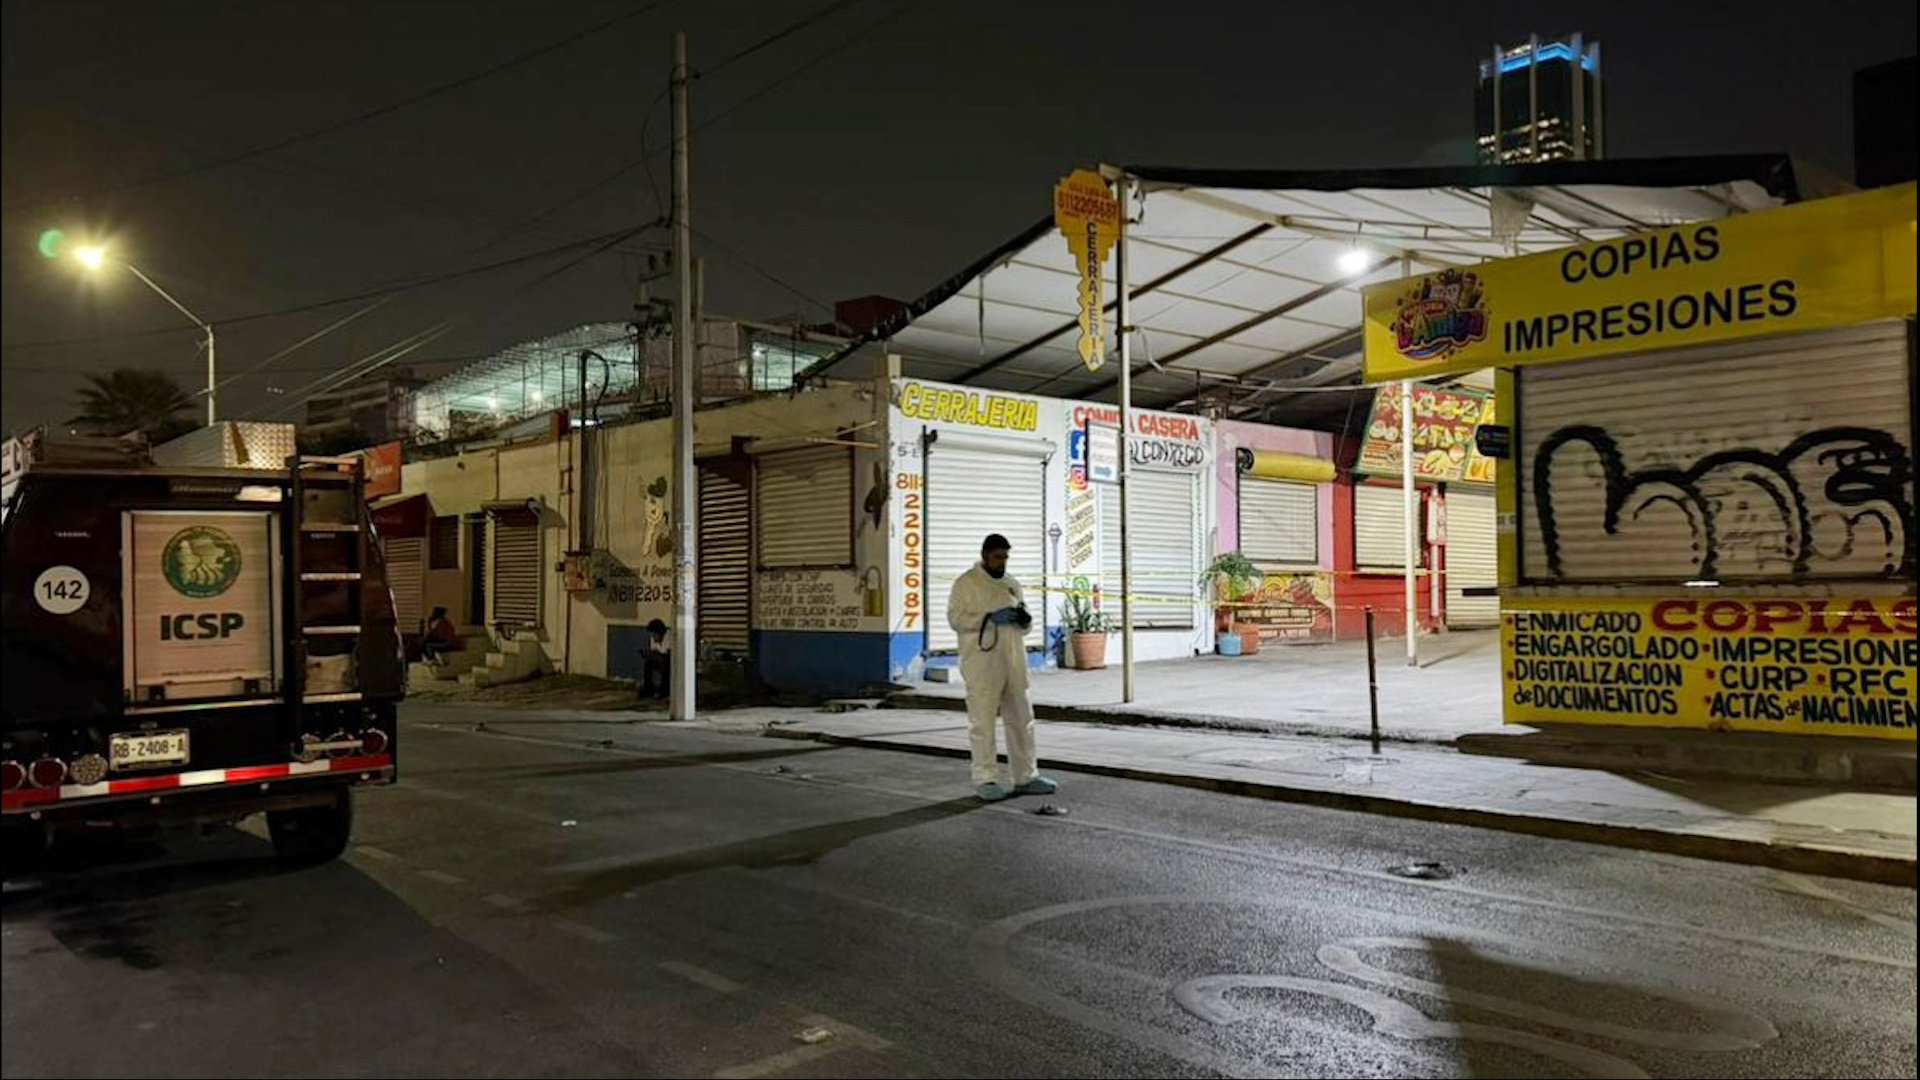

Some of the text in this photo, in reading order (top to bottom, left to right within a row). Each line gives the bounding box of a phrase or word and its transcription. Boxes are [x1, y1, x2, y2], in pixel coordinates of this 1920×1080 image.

[1561, 226, 1720, 283] COPIAS
[1087, 221, 1100, 366] CERRAJERIA
[1503, 279, 1797, 354] IMPRESIONES
[901, 382, 1038, 432] CERRAJERIA
[1138, 414, 1200, 440] CASERA
[43, 580, 83, 600] 142
[160, 612, 244, 641] ICSP
[1514, 613, 1641, 634] ENMICADO
[1651, 599, 1917, 634] COPIAS
[1514, 634, 1699, 661] ENGARGOLADO
[1712, 637, 1917, 667] IMPRESIONE
[1514, 658, 1682, 687] DIGITALIZACION
[1720, 666, 1908, 696] CURP RFC
[1513, 684, 1679, 716] de DOCUMENTOS
[1709, 691, 1784, 720] ACTAS
